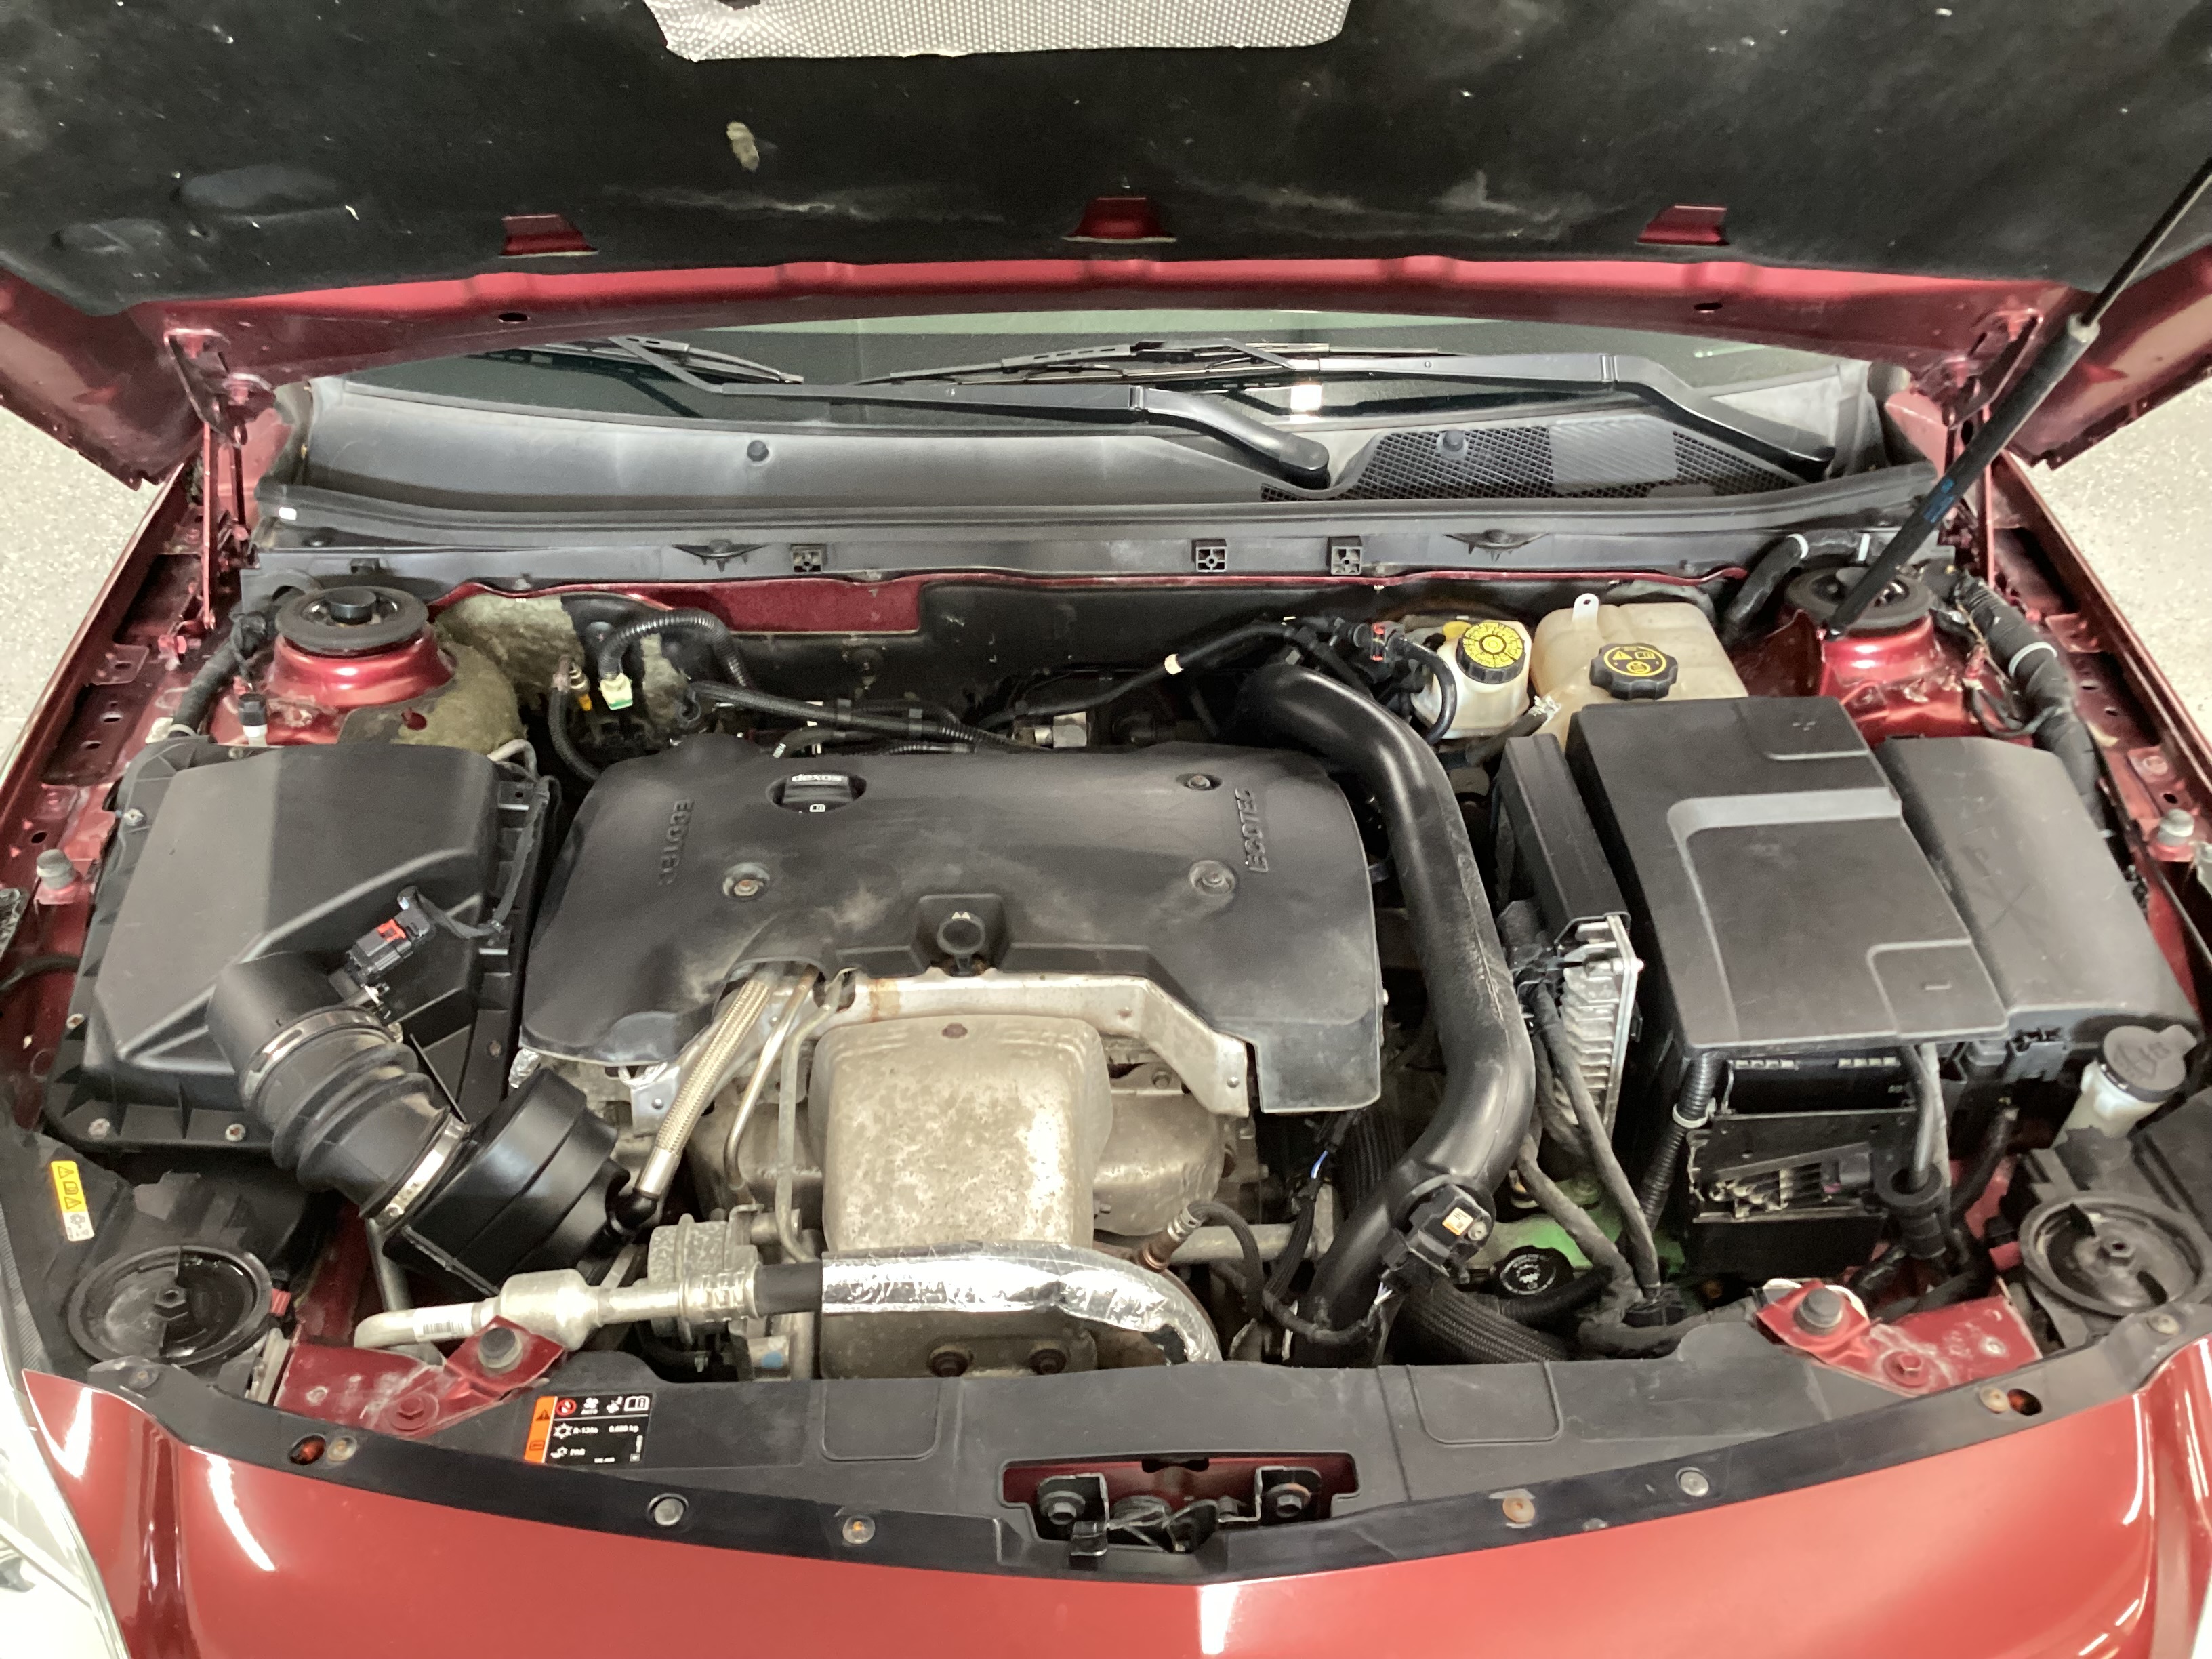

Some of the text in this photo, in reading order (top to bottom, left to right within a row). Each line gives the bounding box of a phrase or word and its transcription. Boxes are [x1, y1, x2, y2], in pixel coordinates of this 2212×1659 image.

[791, 774, 842, 782] dexos
[657, 798, 695, 886] ECOTEC
[1234, 786, 1269, 873] ECOTEC
